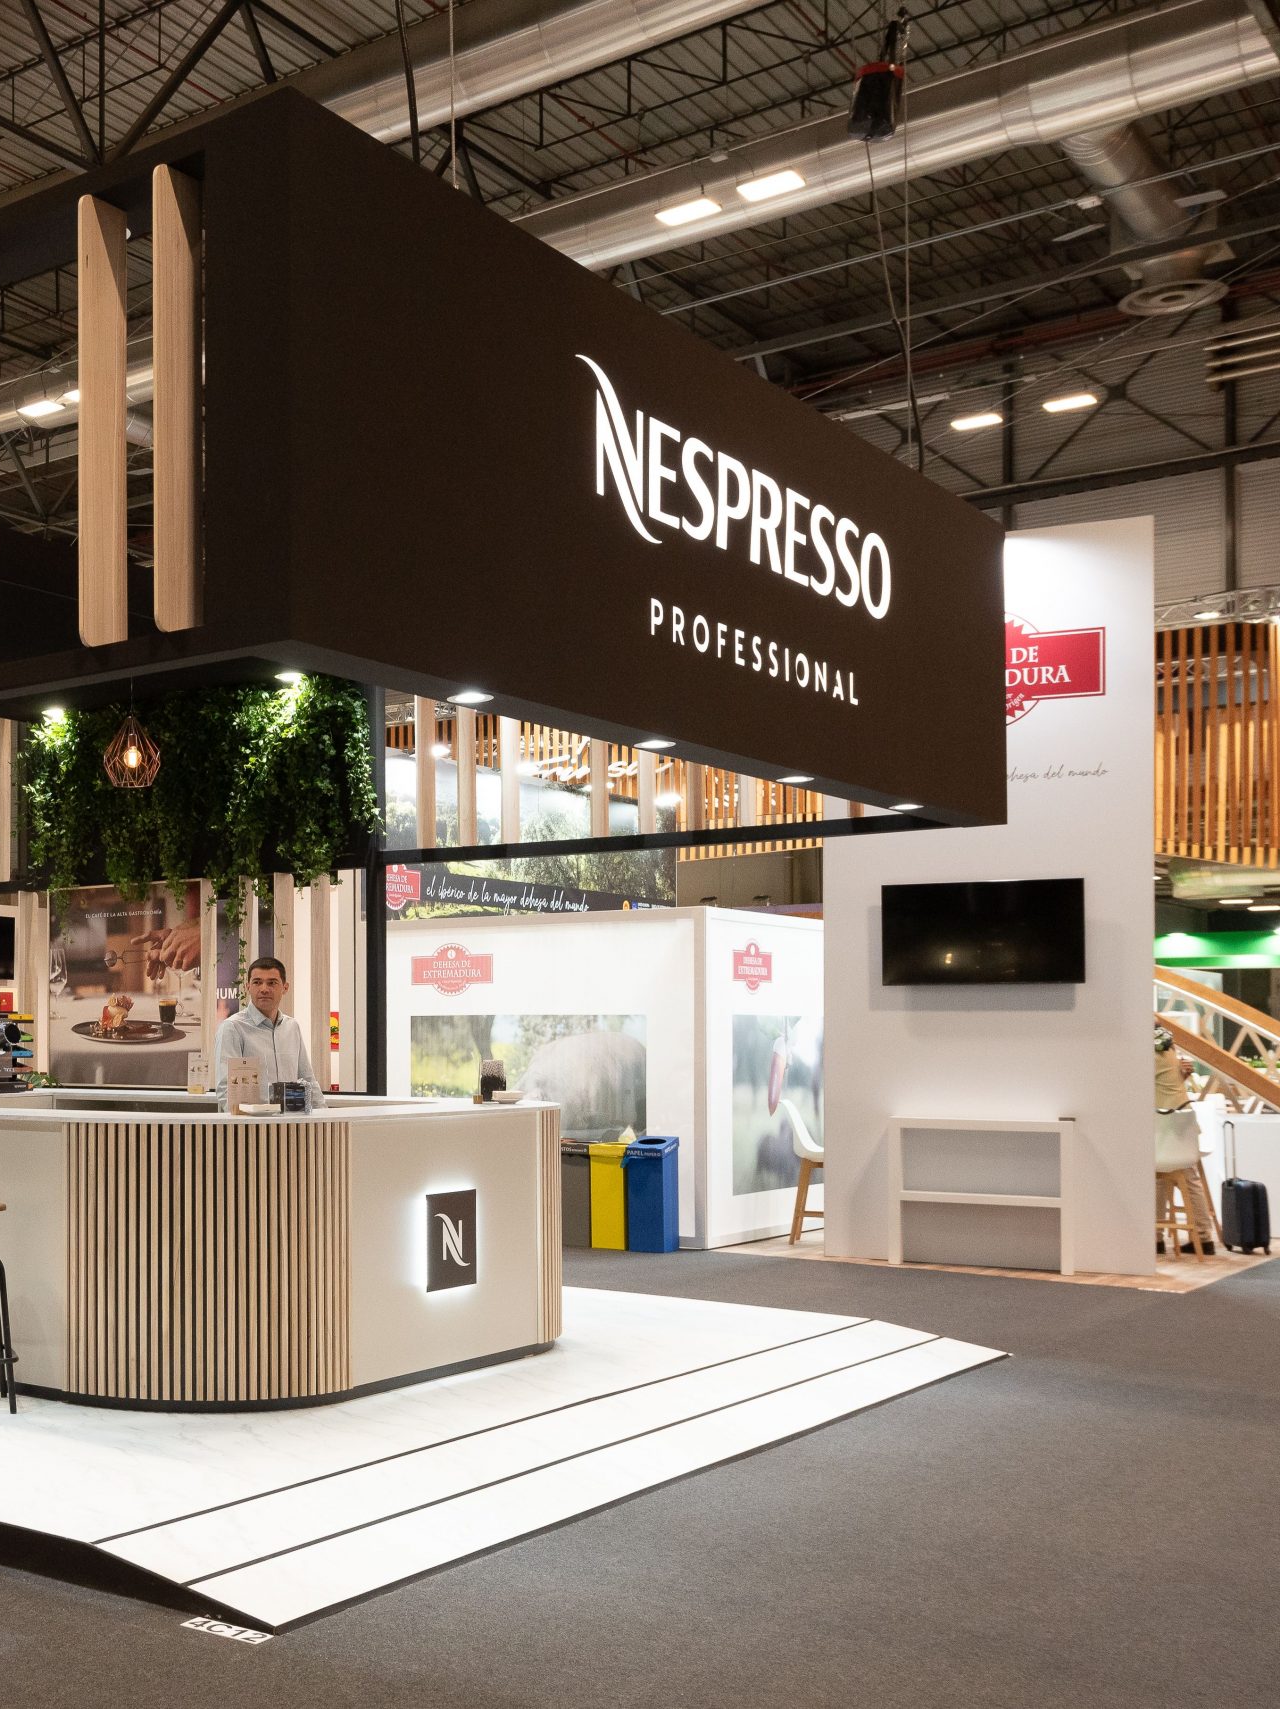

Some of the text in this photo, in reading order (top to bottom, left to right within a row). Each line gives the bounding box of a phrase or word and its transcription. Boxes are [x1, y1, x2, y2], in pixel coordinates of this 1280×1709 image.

[575, 354, 892, 620] NESPRESSO
[650, 597, 859, 706] PROFESSIONAL
[1010, 646, 1039, 664] DE
[426, 875, 436, 897] el
[468, 880, 479, 903] de
[481, 880, 491, 903] la
[493, 892, 518, 916] mayor
[550, 890, 564, 911] del
[423, 969, 481, 979] EXTREMADURA
[433, 960, 471, 969] DEHESA DE
[189, 1620, 268, 1642] 4C12
